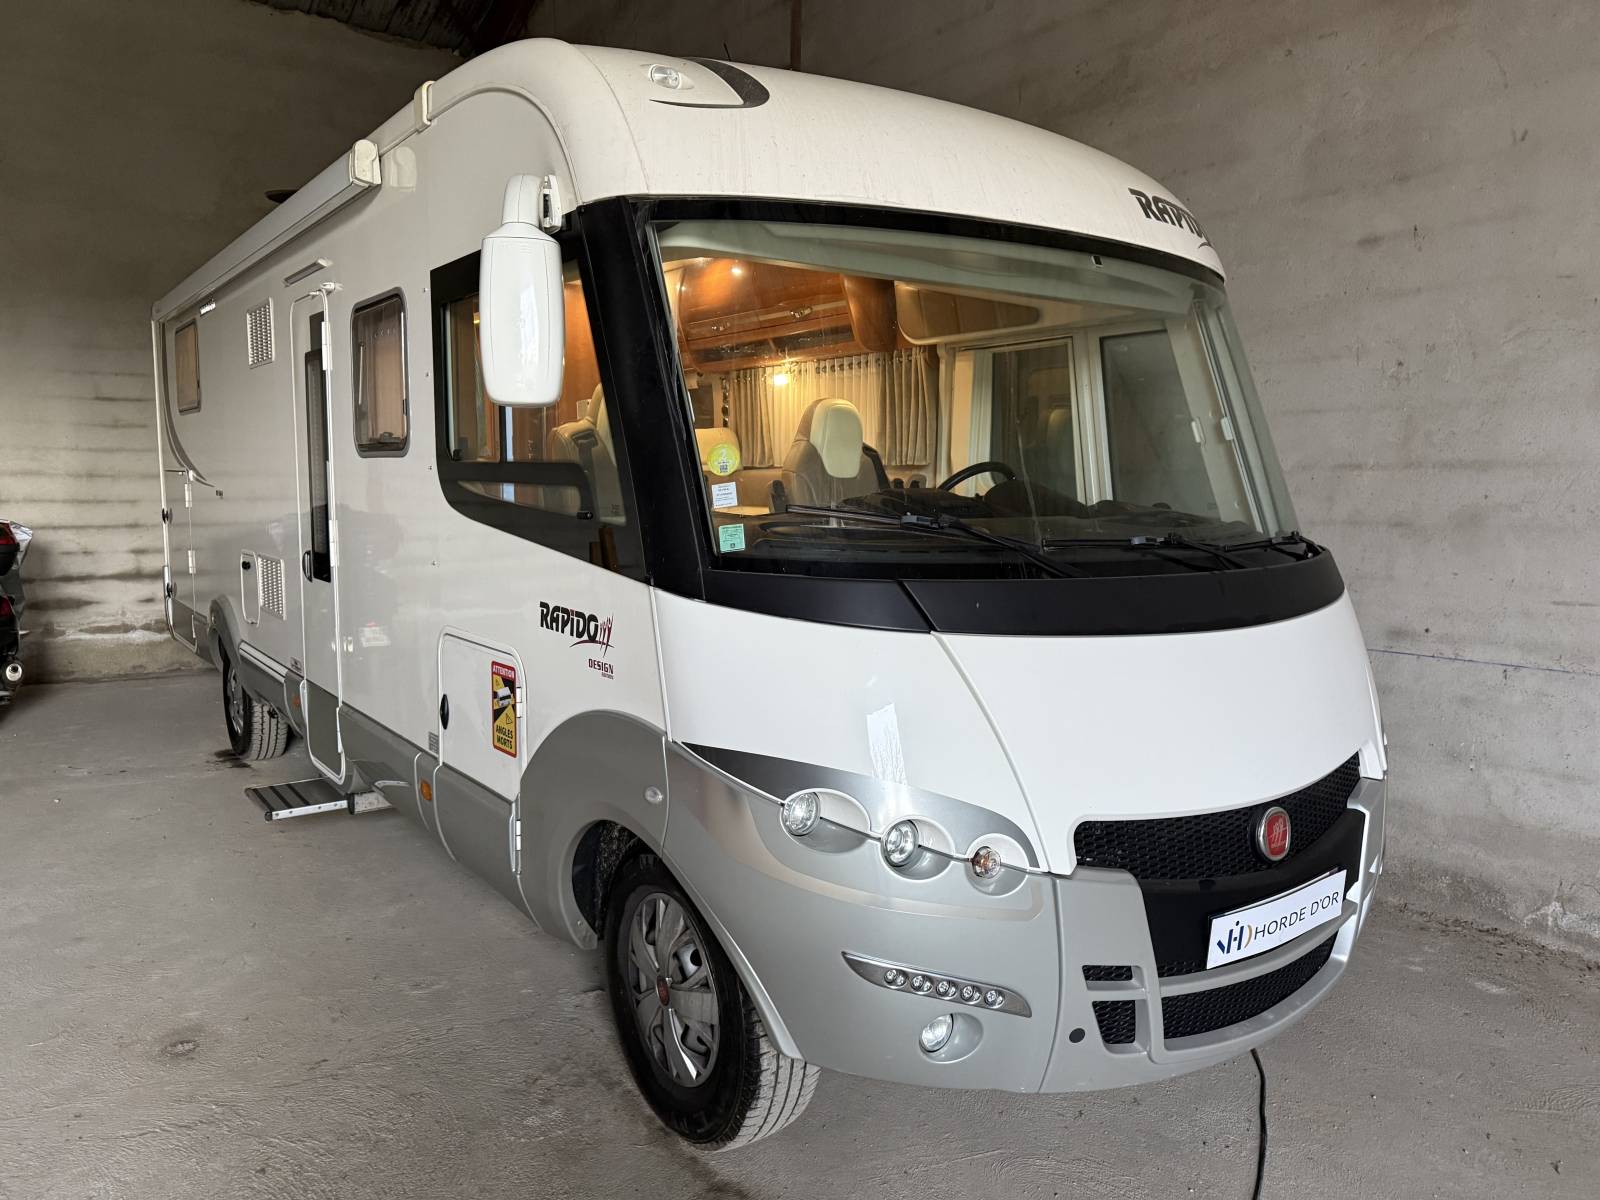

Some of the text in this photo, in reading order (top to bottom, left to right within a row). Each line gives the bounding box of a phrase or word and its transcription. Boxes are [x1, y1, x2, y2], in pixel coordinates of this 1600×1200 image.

[539, 601, 599, 641] RAPIDO
[588, 658, 614, 675] DESIGN
[496, 724, 513, 739] ANGLES
[496, 735, 513, 749] MORTS
[1254, 906, 1307, 940] HORDE
[1310, 891, 1339, 916] D'OR
